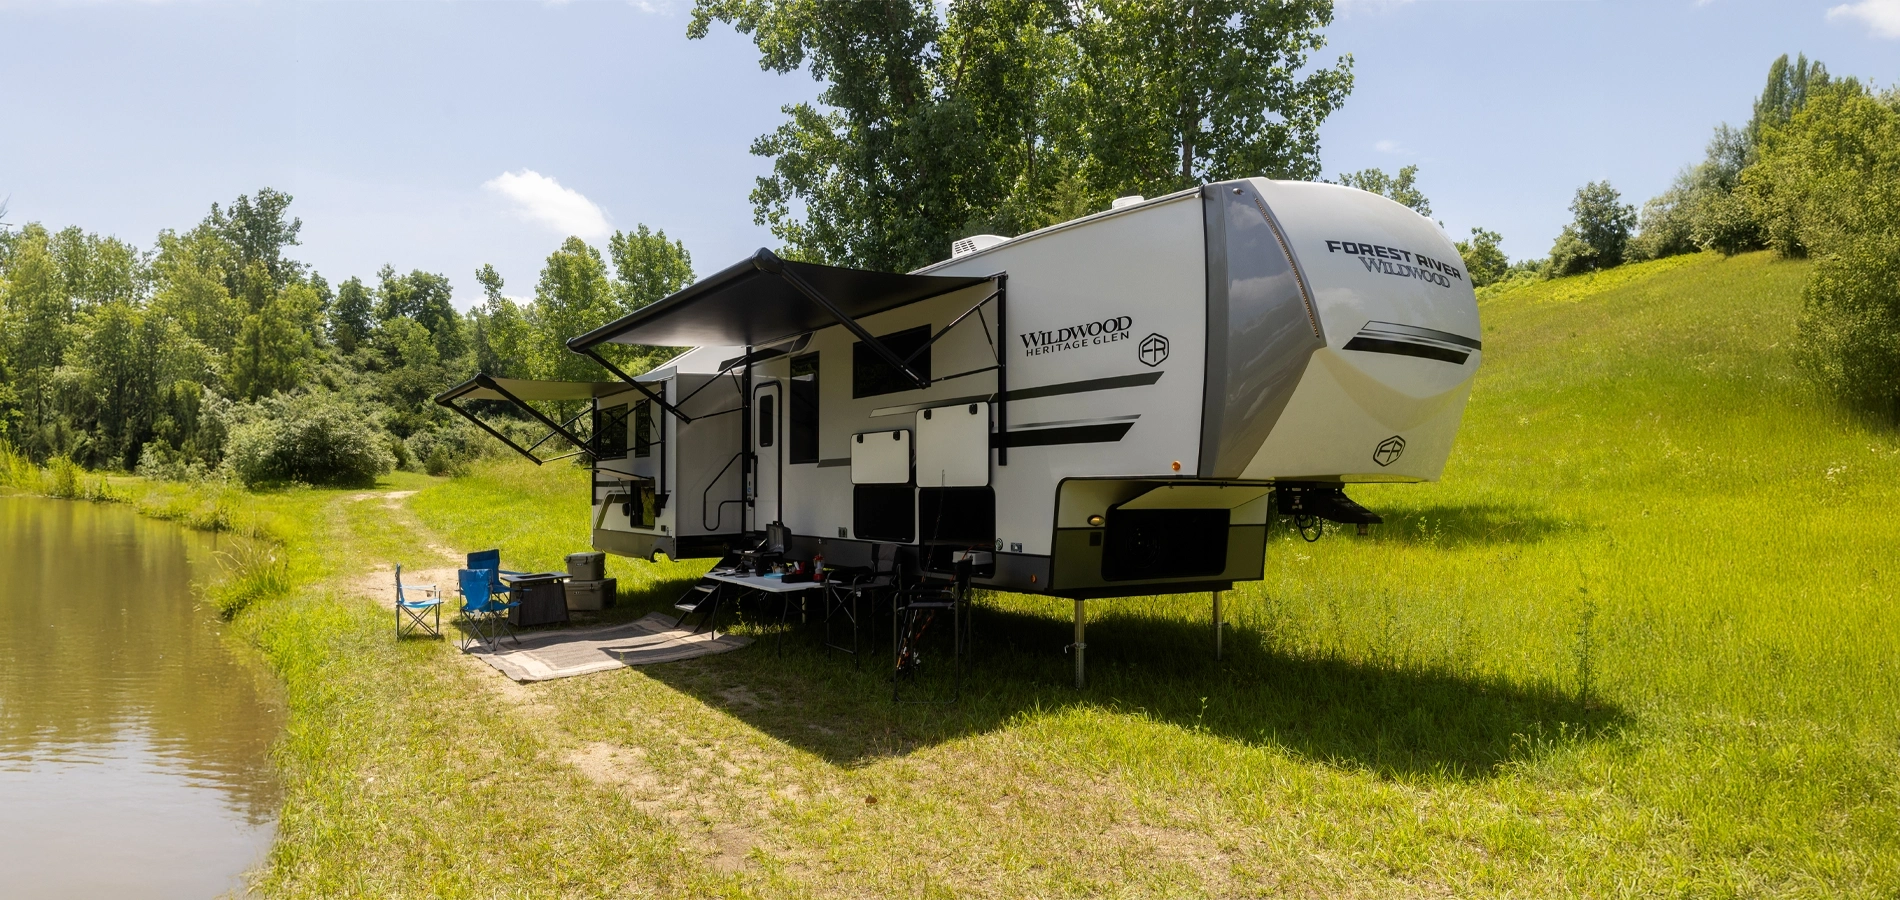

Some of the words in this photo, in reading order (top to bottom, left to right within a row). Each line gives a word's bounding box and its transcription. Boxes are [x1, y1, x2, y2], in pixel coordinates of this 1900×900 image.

[1325, 240, 1411, 263] FOREST
[1415, 253, 1462, 281] RIVER
[1358, 256, 1450, 288] WILDWOOD
[1020, 315, 1133, 349] WILDWOOD
[1026, 338, 1089, 357] HERITAGE
[1093, 331, 1130, 345] GLEN
